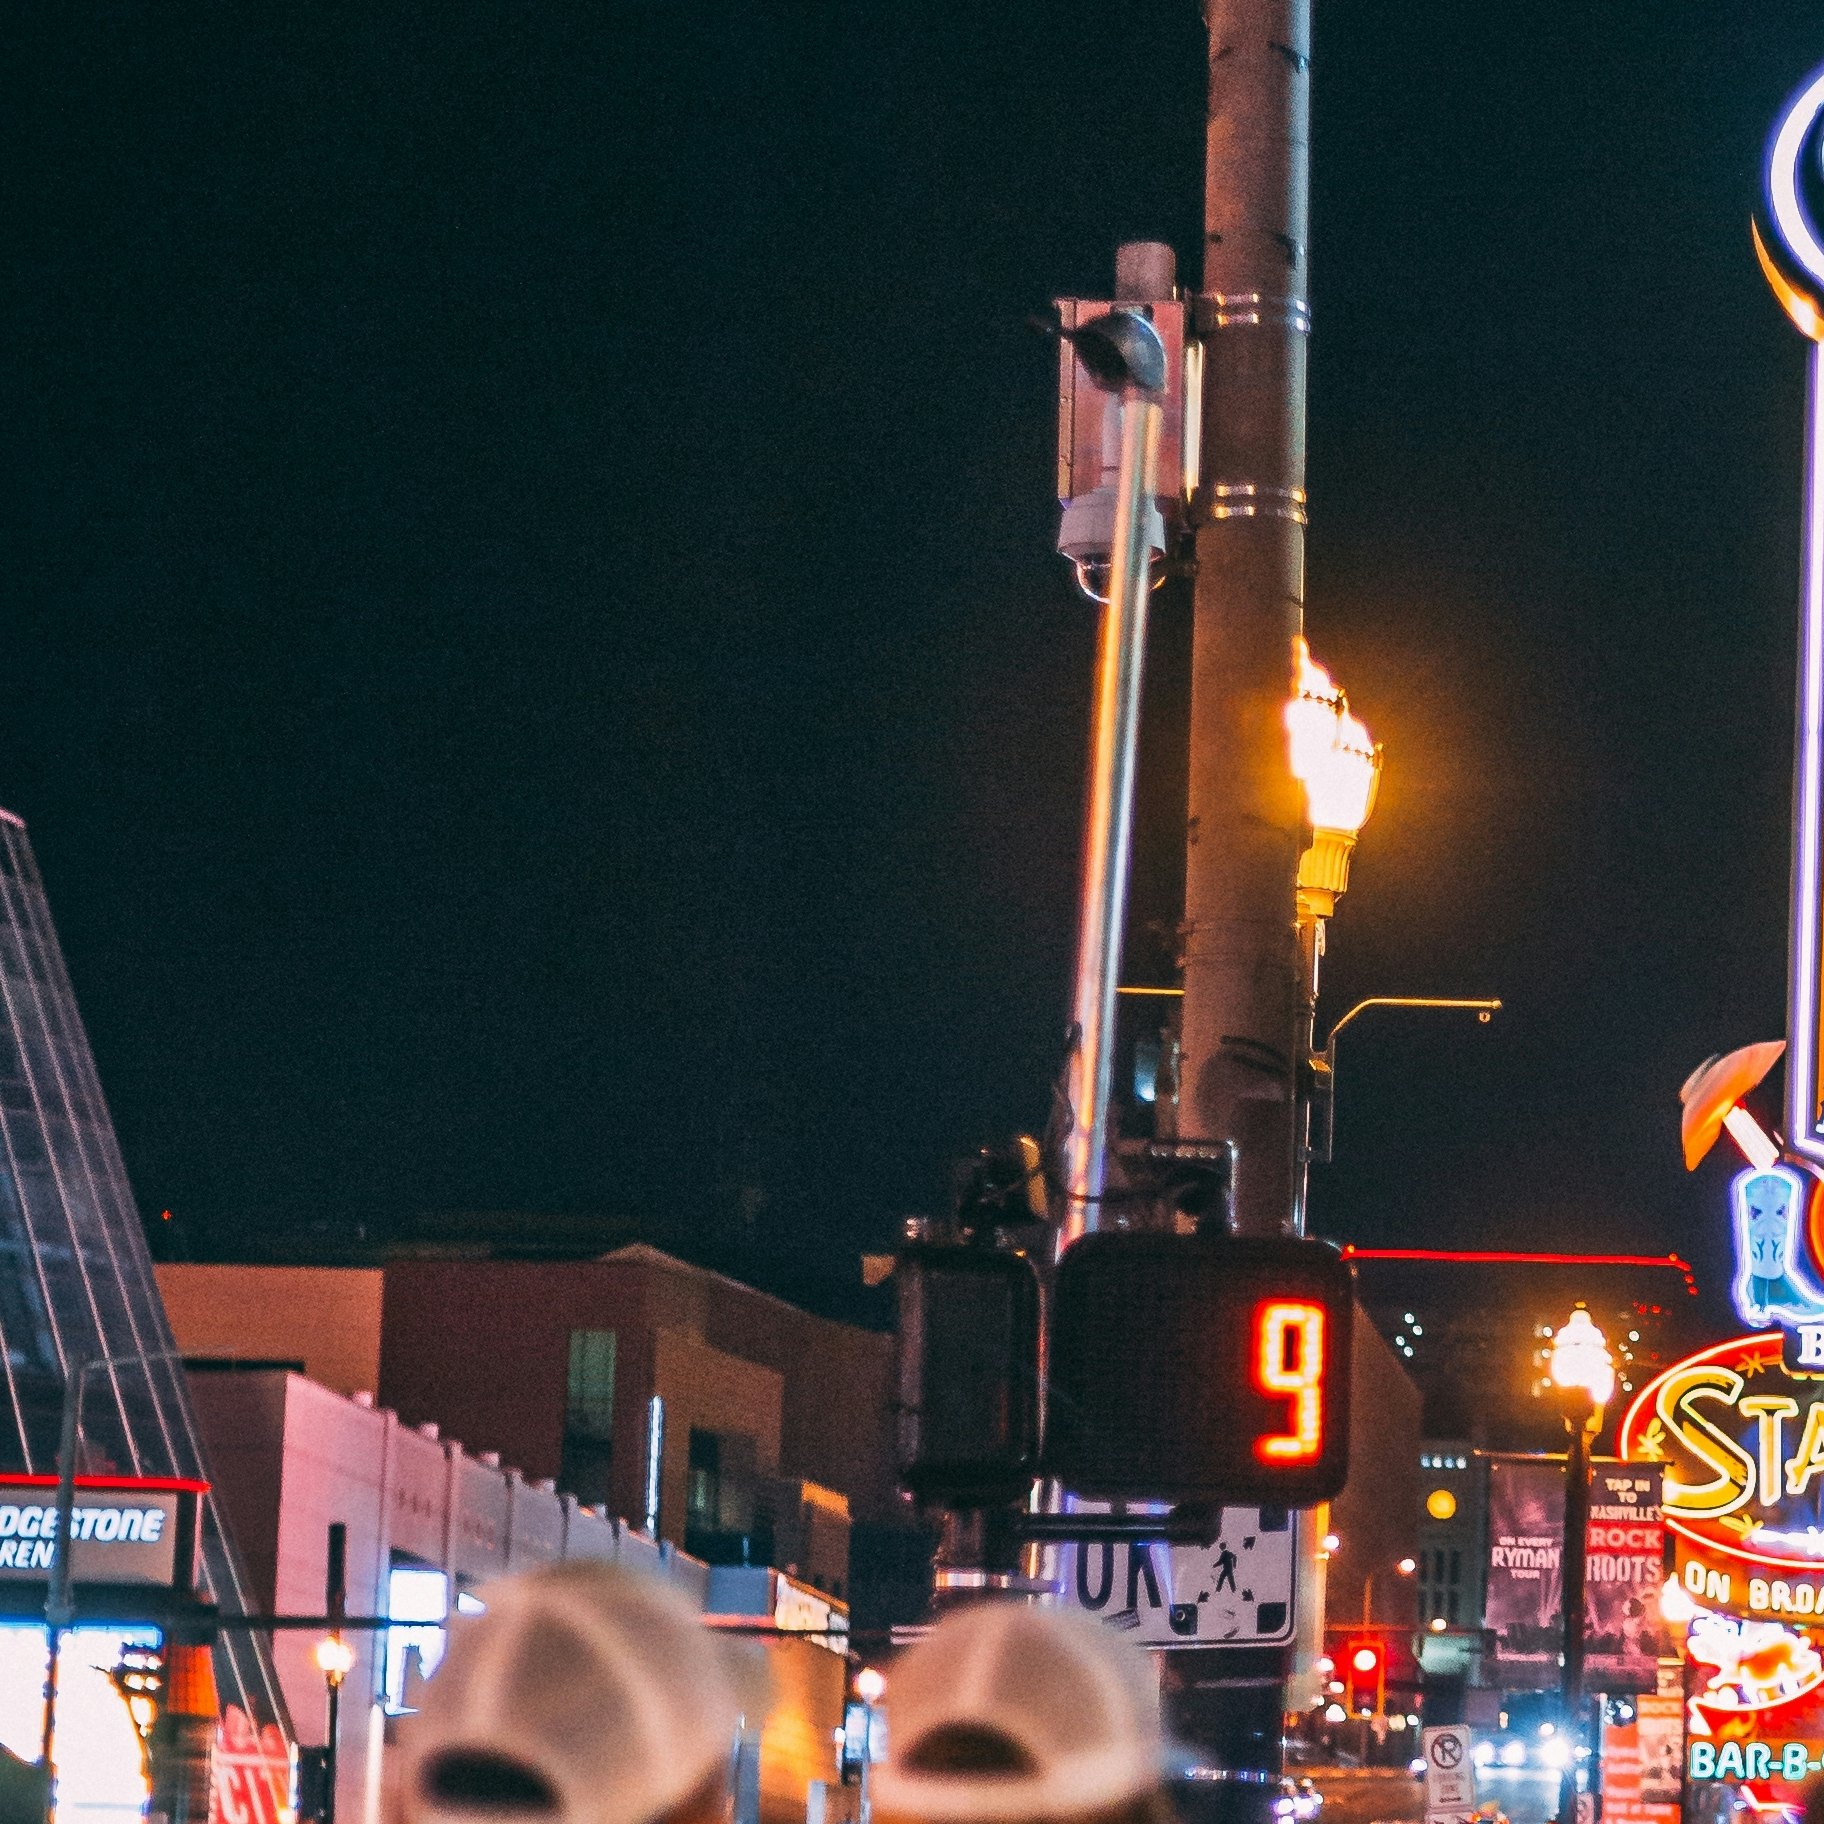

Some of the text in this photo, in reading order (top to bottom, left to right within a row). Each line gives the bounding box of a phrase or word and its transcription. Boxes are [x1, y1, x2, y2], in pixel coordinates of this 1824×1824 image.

[1255, 1300, 1326, 1465] 9
[1604, 1477, 1651, 1492] TAP IN
[1618, 1491, 1638, 1504] TO
[1590, 1528, 1662, 1549] ROCK
[1491, 1546, 1561, 1569] RYMAN
[1510, 1569, 1541, 1580] TOUR
[1684, 1560, 1731, 1604] ON
